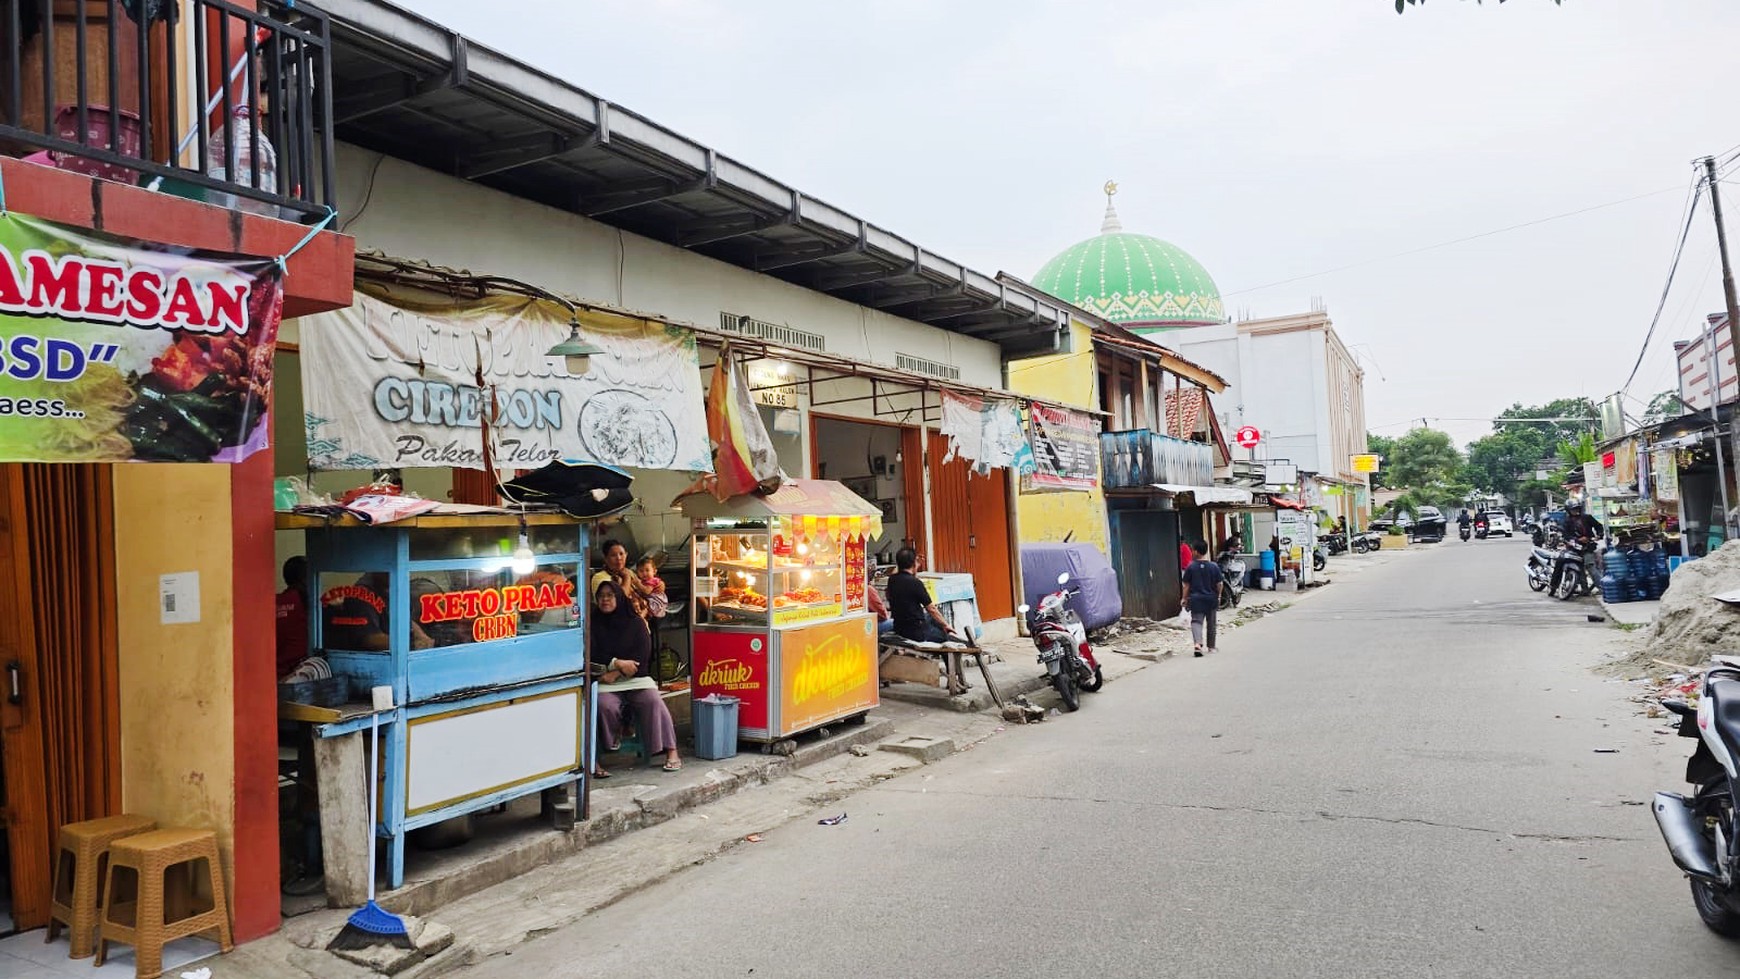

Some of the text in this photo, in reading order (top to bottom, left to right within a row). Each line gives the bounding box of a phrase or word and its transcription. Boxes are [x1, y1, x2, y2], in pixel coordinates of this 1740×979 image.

[761, 392, 774, 404] NO
[501, 439, 561, 462] Telor
[320, 585, 386, 614] KETOPRAK
[420, 581, 575, 623] KETO PRAK
[473, 612, 518, 642] CRBN
[699, 659, 753, 688] dkriuk
